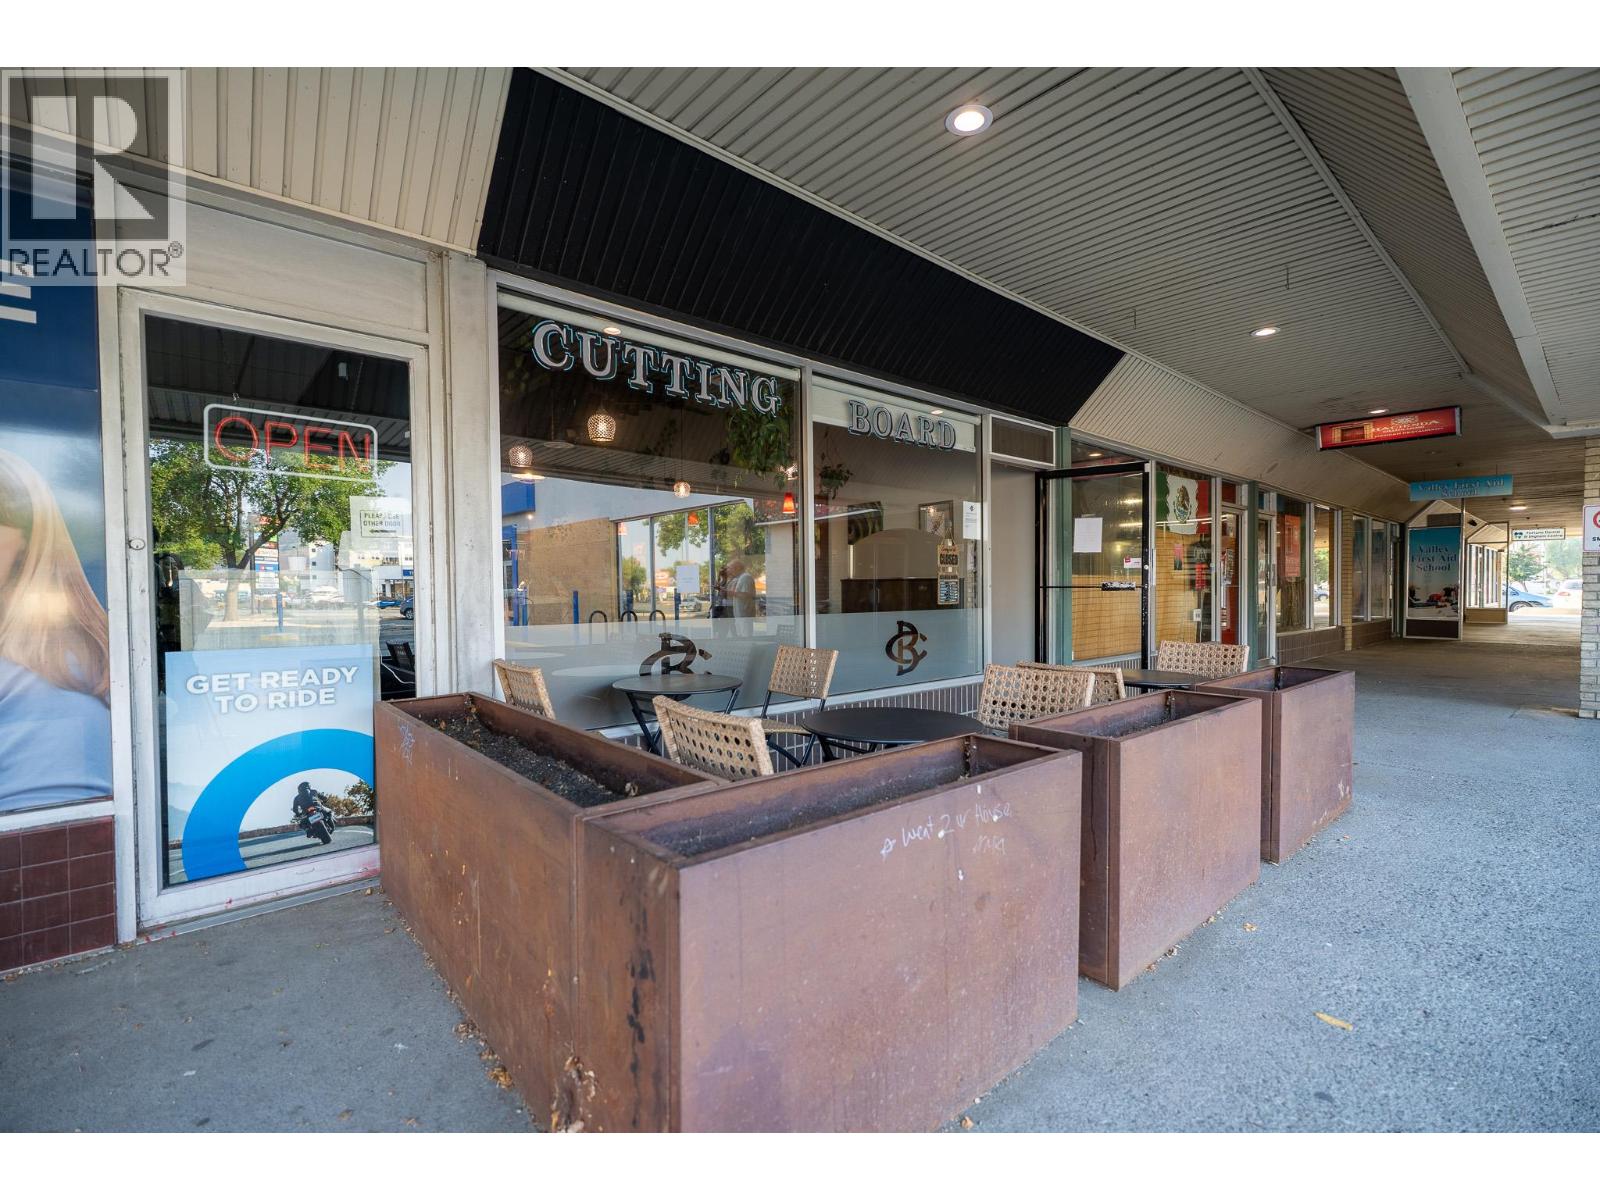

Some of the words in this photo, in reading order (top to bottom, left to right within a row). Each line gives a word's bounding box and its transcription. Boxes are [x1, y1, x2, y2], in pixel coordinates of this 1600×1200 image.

[532, 319, 782, 417] CUTTING
[847, 400, 957, 451] BOARD
[214, 416, 371, 473] OPEN
[1486, 478, 1504, 487] Aid
[1416, 563, 1450, 571] School
[1440, 553, 1457, 562] Aid
[186, 672, 251, 695] GET
[260, 666, 358, 690] READY
[214, 693, 259, 714] TO
[267, 687, 336, 710] RIDE
